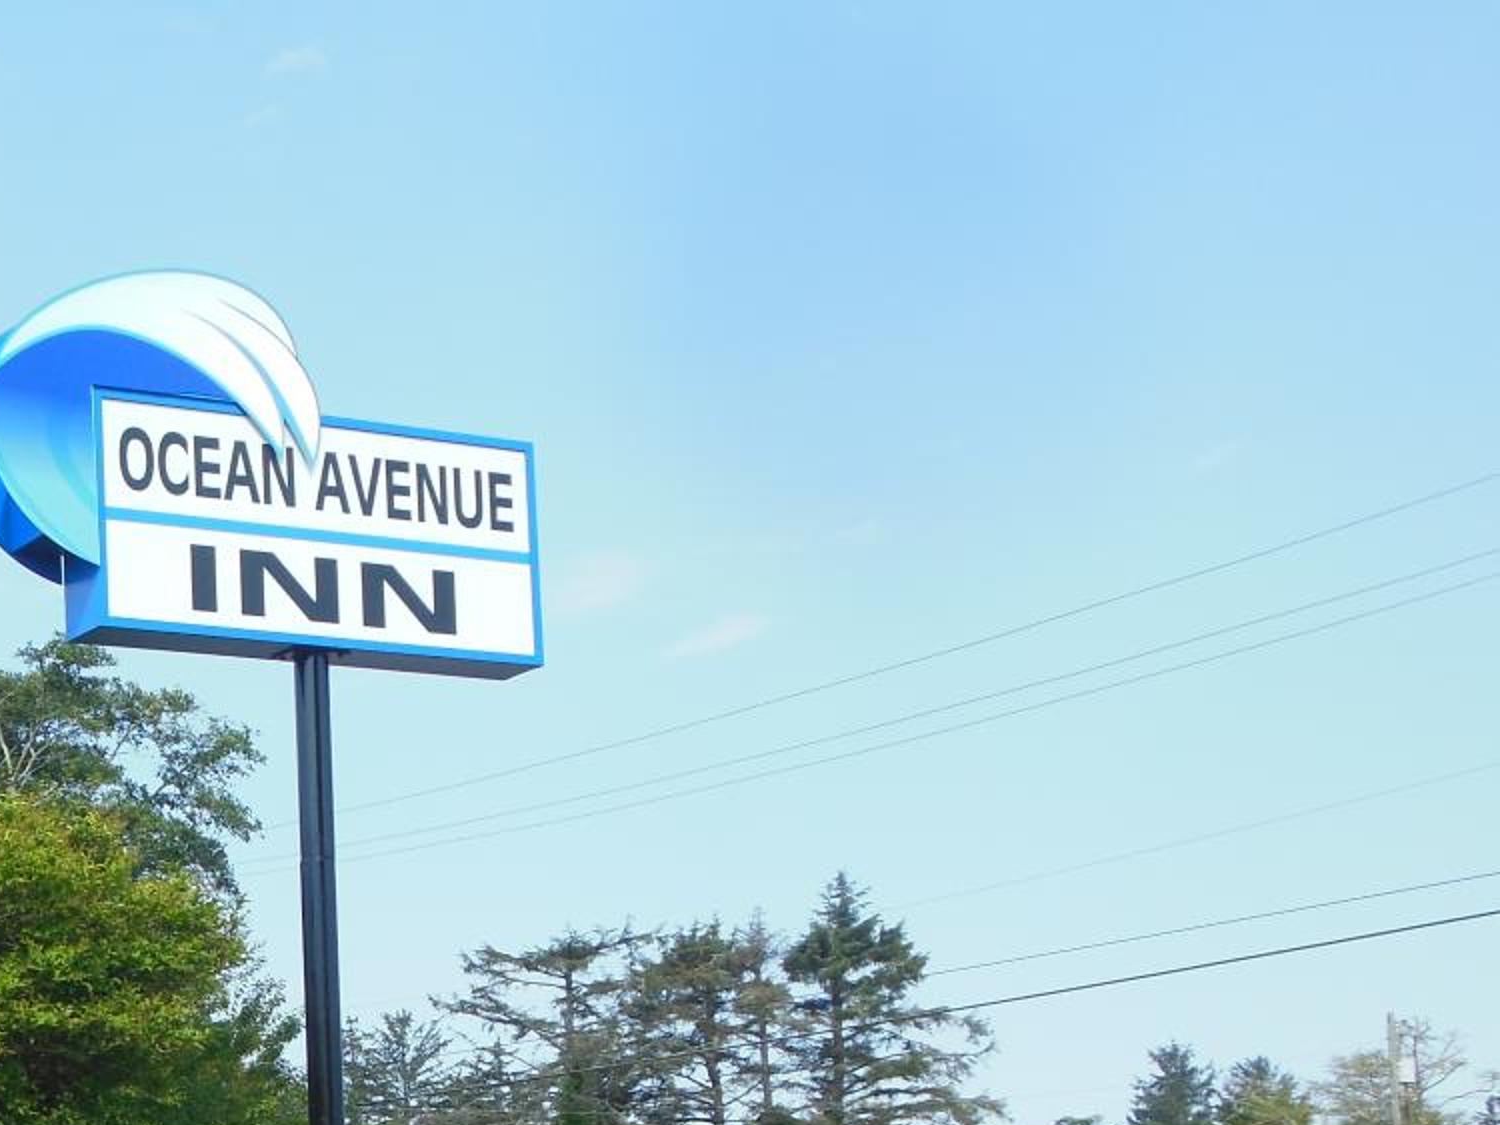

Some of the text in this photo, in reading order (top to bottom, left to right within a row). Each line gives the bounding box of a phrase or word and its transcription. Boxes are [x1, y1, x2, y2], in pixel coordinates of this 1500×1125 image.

[119, 426, 514, 533] OCEAN AVENUE
[190, 543, 457, 636] INN
